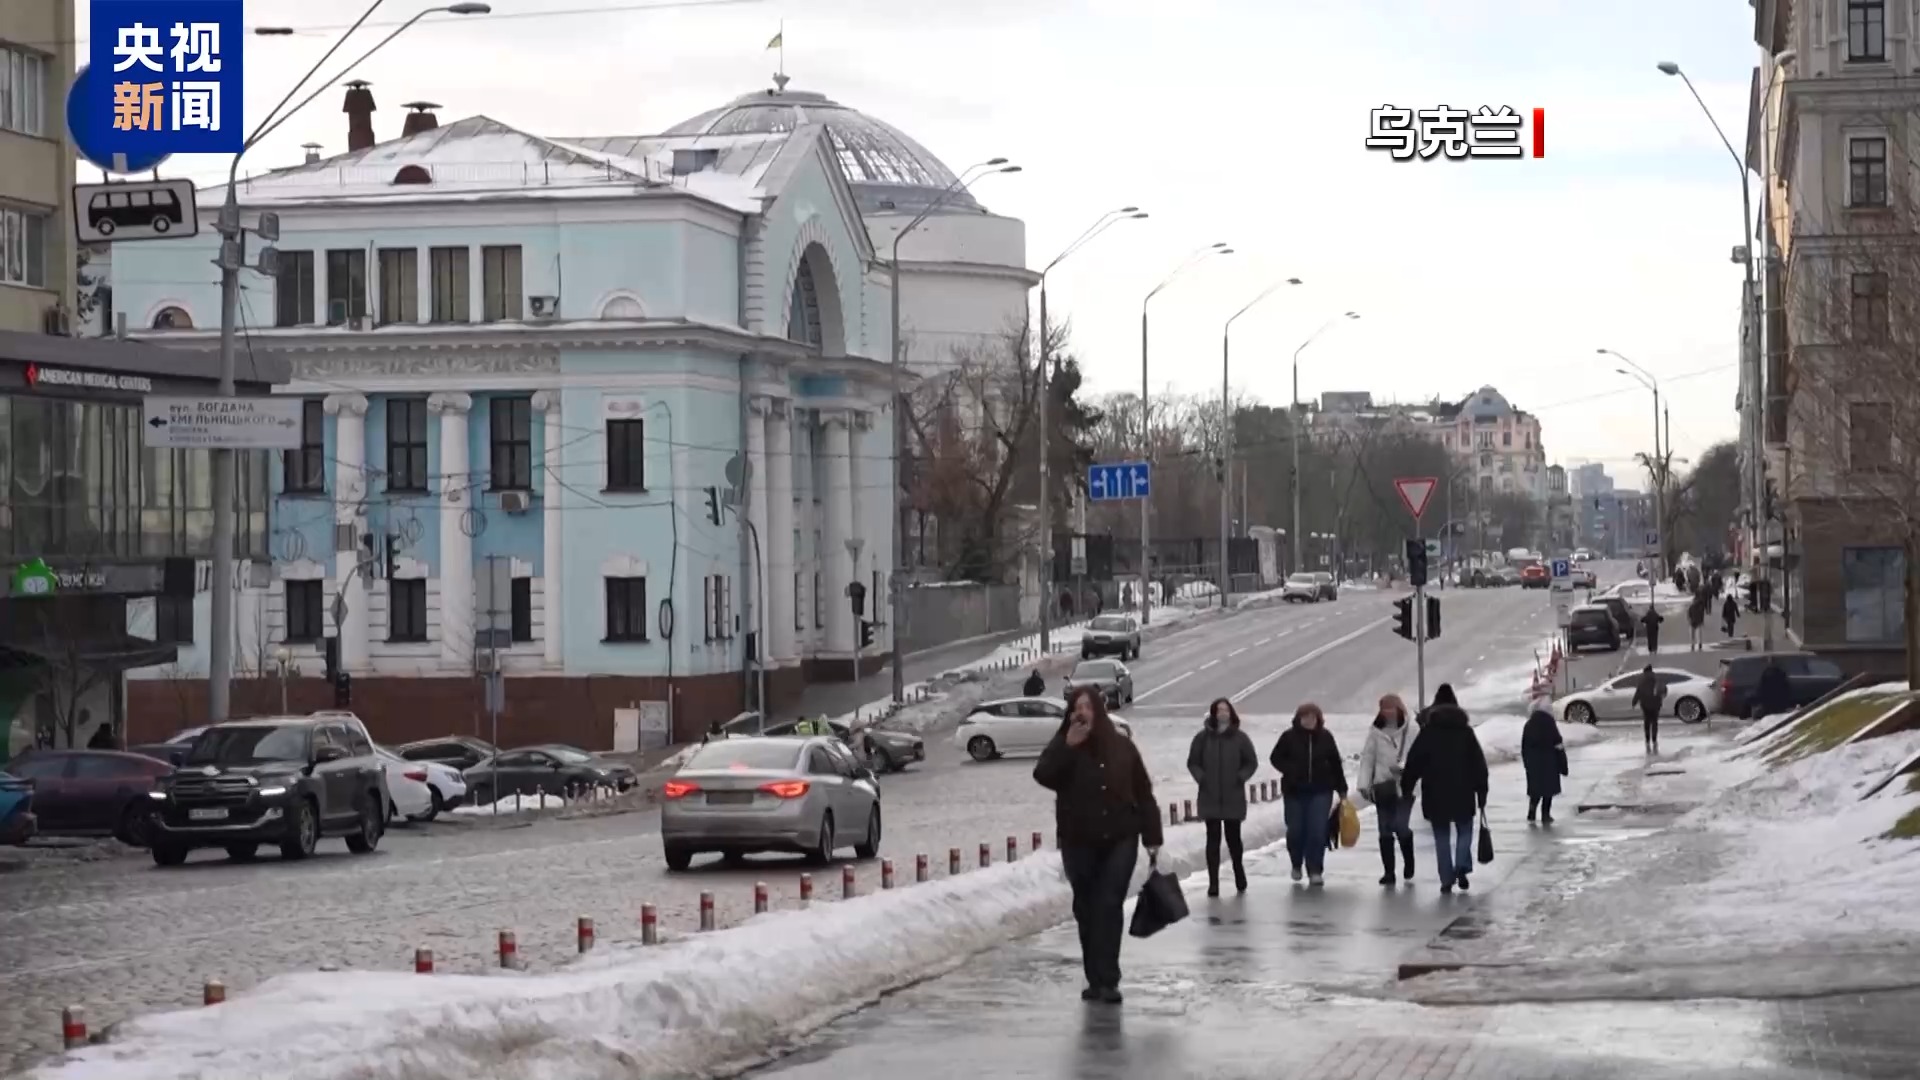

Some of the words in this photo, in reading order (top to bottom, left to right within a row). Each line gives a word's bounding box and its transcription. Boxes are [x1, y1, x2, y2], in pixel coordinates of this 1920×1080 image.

[38, 367, 81, 384] AMERICAN
[84, 372, 118, 389] MEDICAL
[119, 375, 152, 392] CENTERS
[197, 402, 254, 413] БОГДАНА
